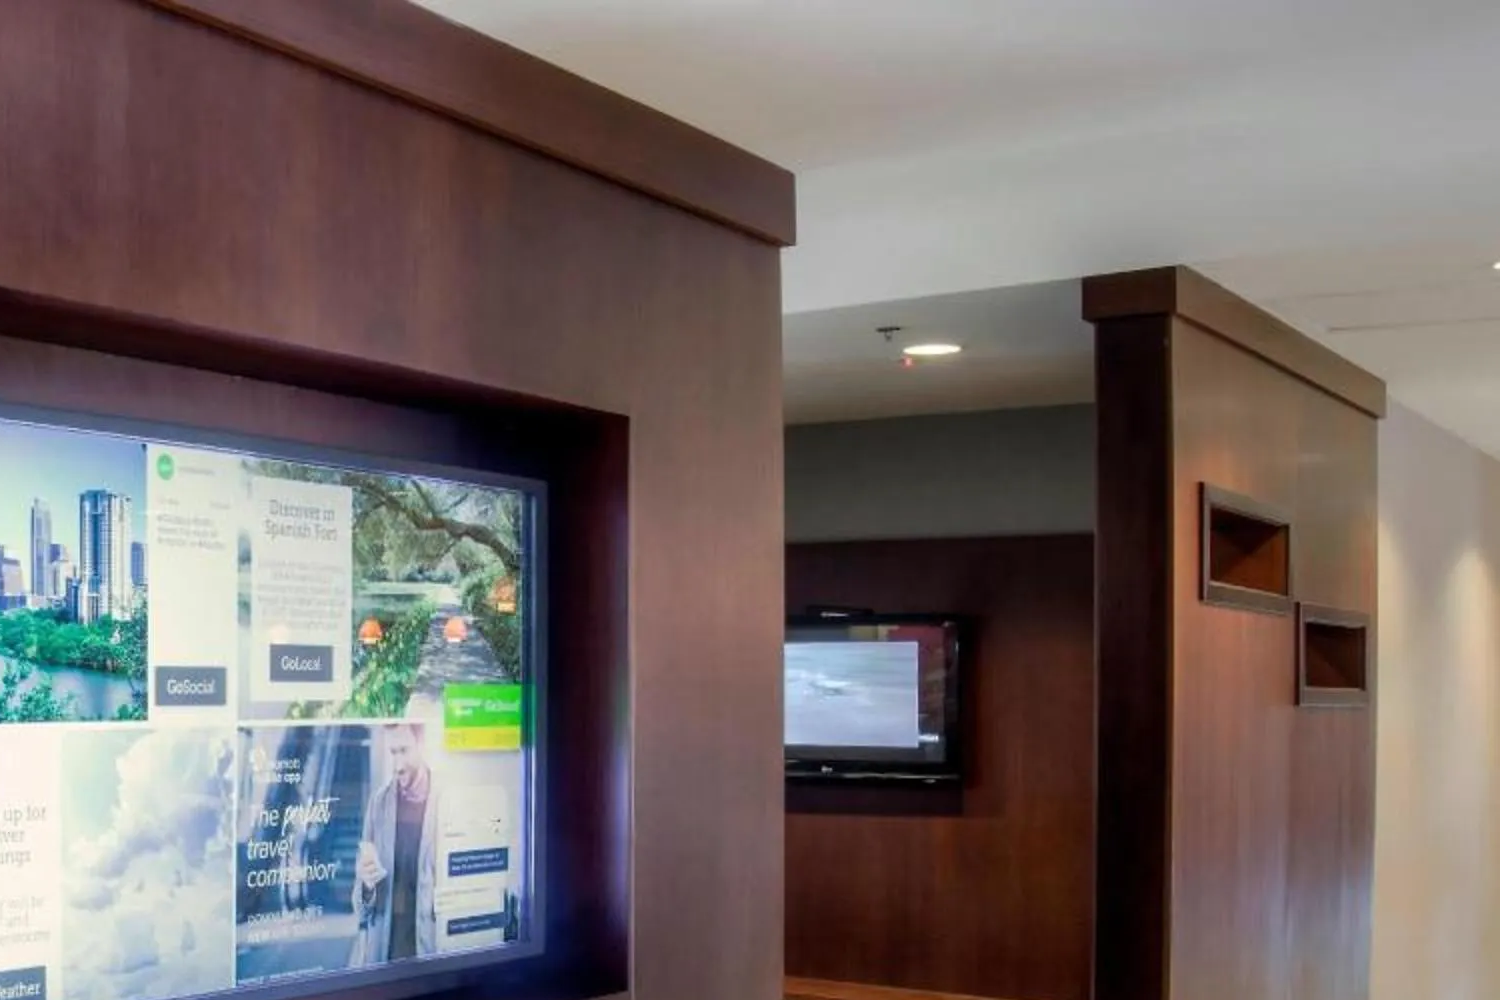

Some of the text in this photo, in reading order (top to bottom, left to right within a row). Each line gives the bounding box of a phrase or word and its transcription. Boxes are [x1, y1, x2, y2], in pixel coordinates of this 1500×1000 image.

[280, 656, 323, 672] GoLocal
[166, 679, 217, 696] GoSocial
[3, 807, 24, 827] up
[26, 804, 47, 821] for
[247, 833, 294, 861] travel
[246, 859, 337, 889] companion
